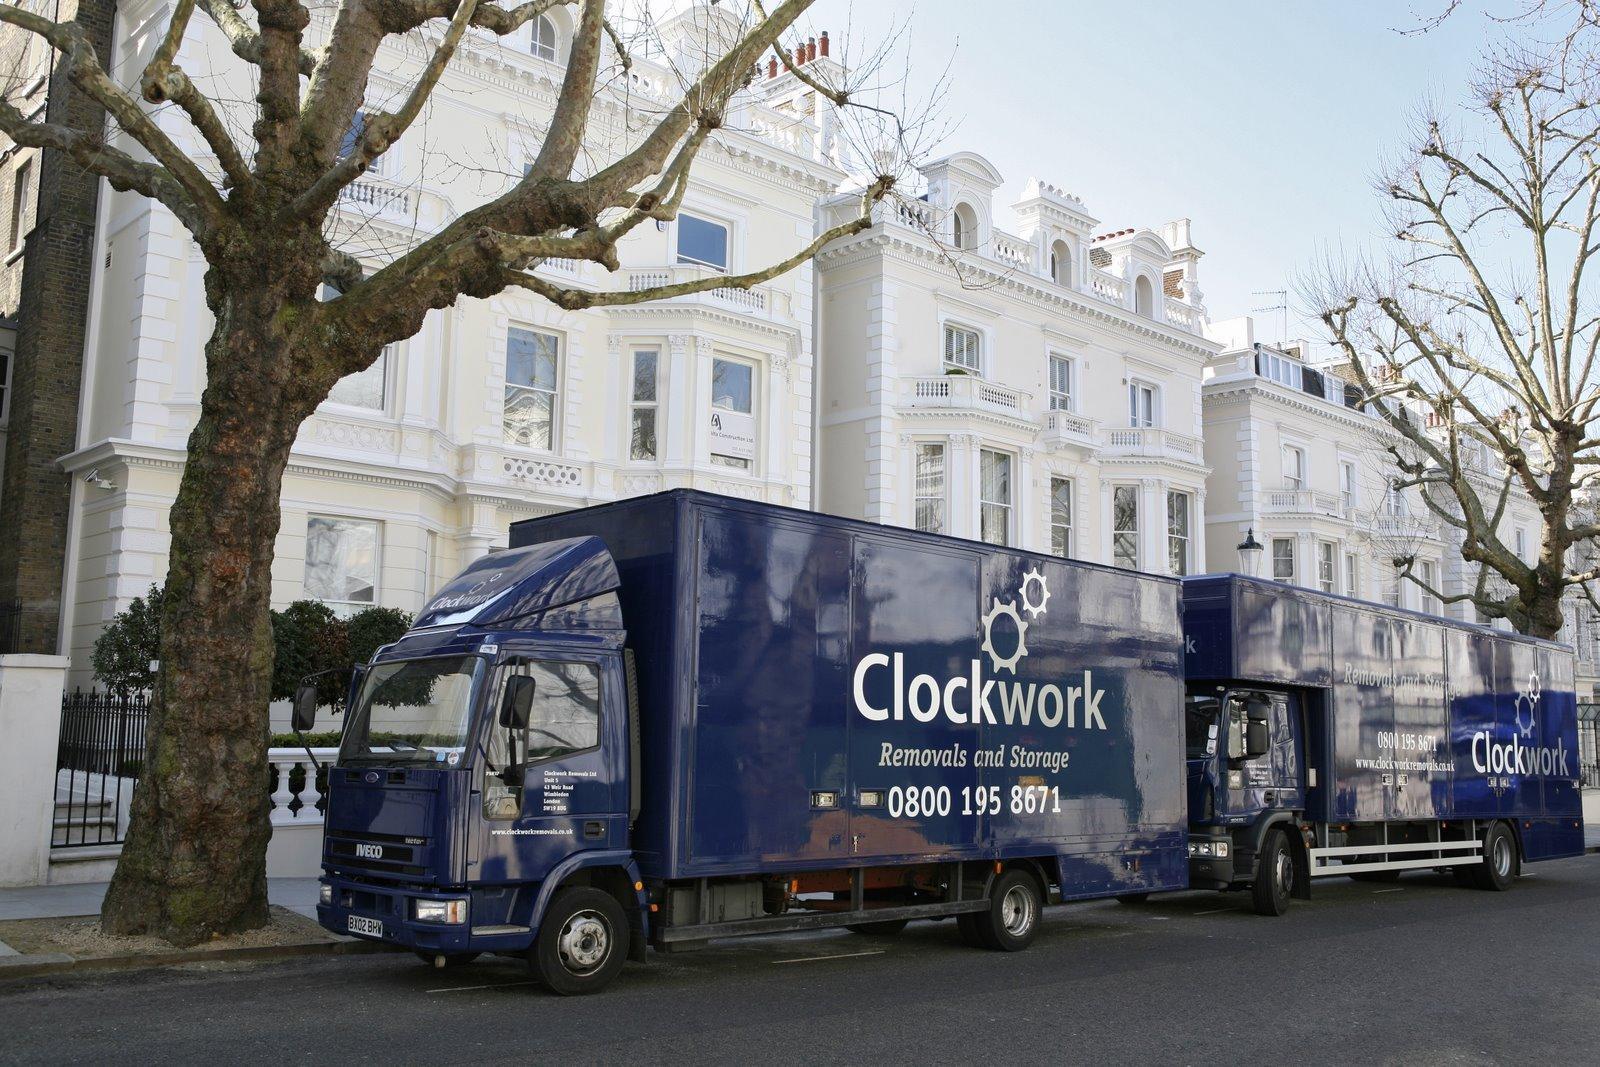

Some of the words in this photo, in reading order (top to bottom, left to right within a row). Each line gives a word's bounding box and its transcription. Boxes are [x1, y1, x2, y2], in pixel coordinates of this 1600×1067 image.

[1343, 662, 1397, 690] Removals
[1400, 673, 1420, 692] and
[853, 652, 1107, 730] Clockwork
[1377, 731, 1398, 750] 0800
[1401, 733, 1416, 750] 195
[1418, 734, 1437, 751] 8671
[1471, 731, 1569, 776] Clockwork
[879, 742, 967, 768] Removals
[973, 745, 1005, 767] and
[1010, 745, 1069, 773] Storage
[1355, 756, 1455, 772] www.clockworkremovals.co.uk
[888, 785, 951, 818] 0800
[961, 785, 1001, 816] 195
[1010, 785, 1062, 815] 8671
[491, 828, 573, 836] www.clockworkremovals.co.uk
[356, 843, 383, 859] IVECO
[349, 917, 367, 932] BX02
